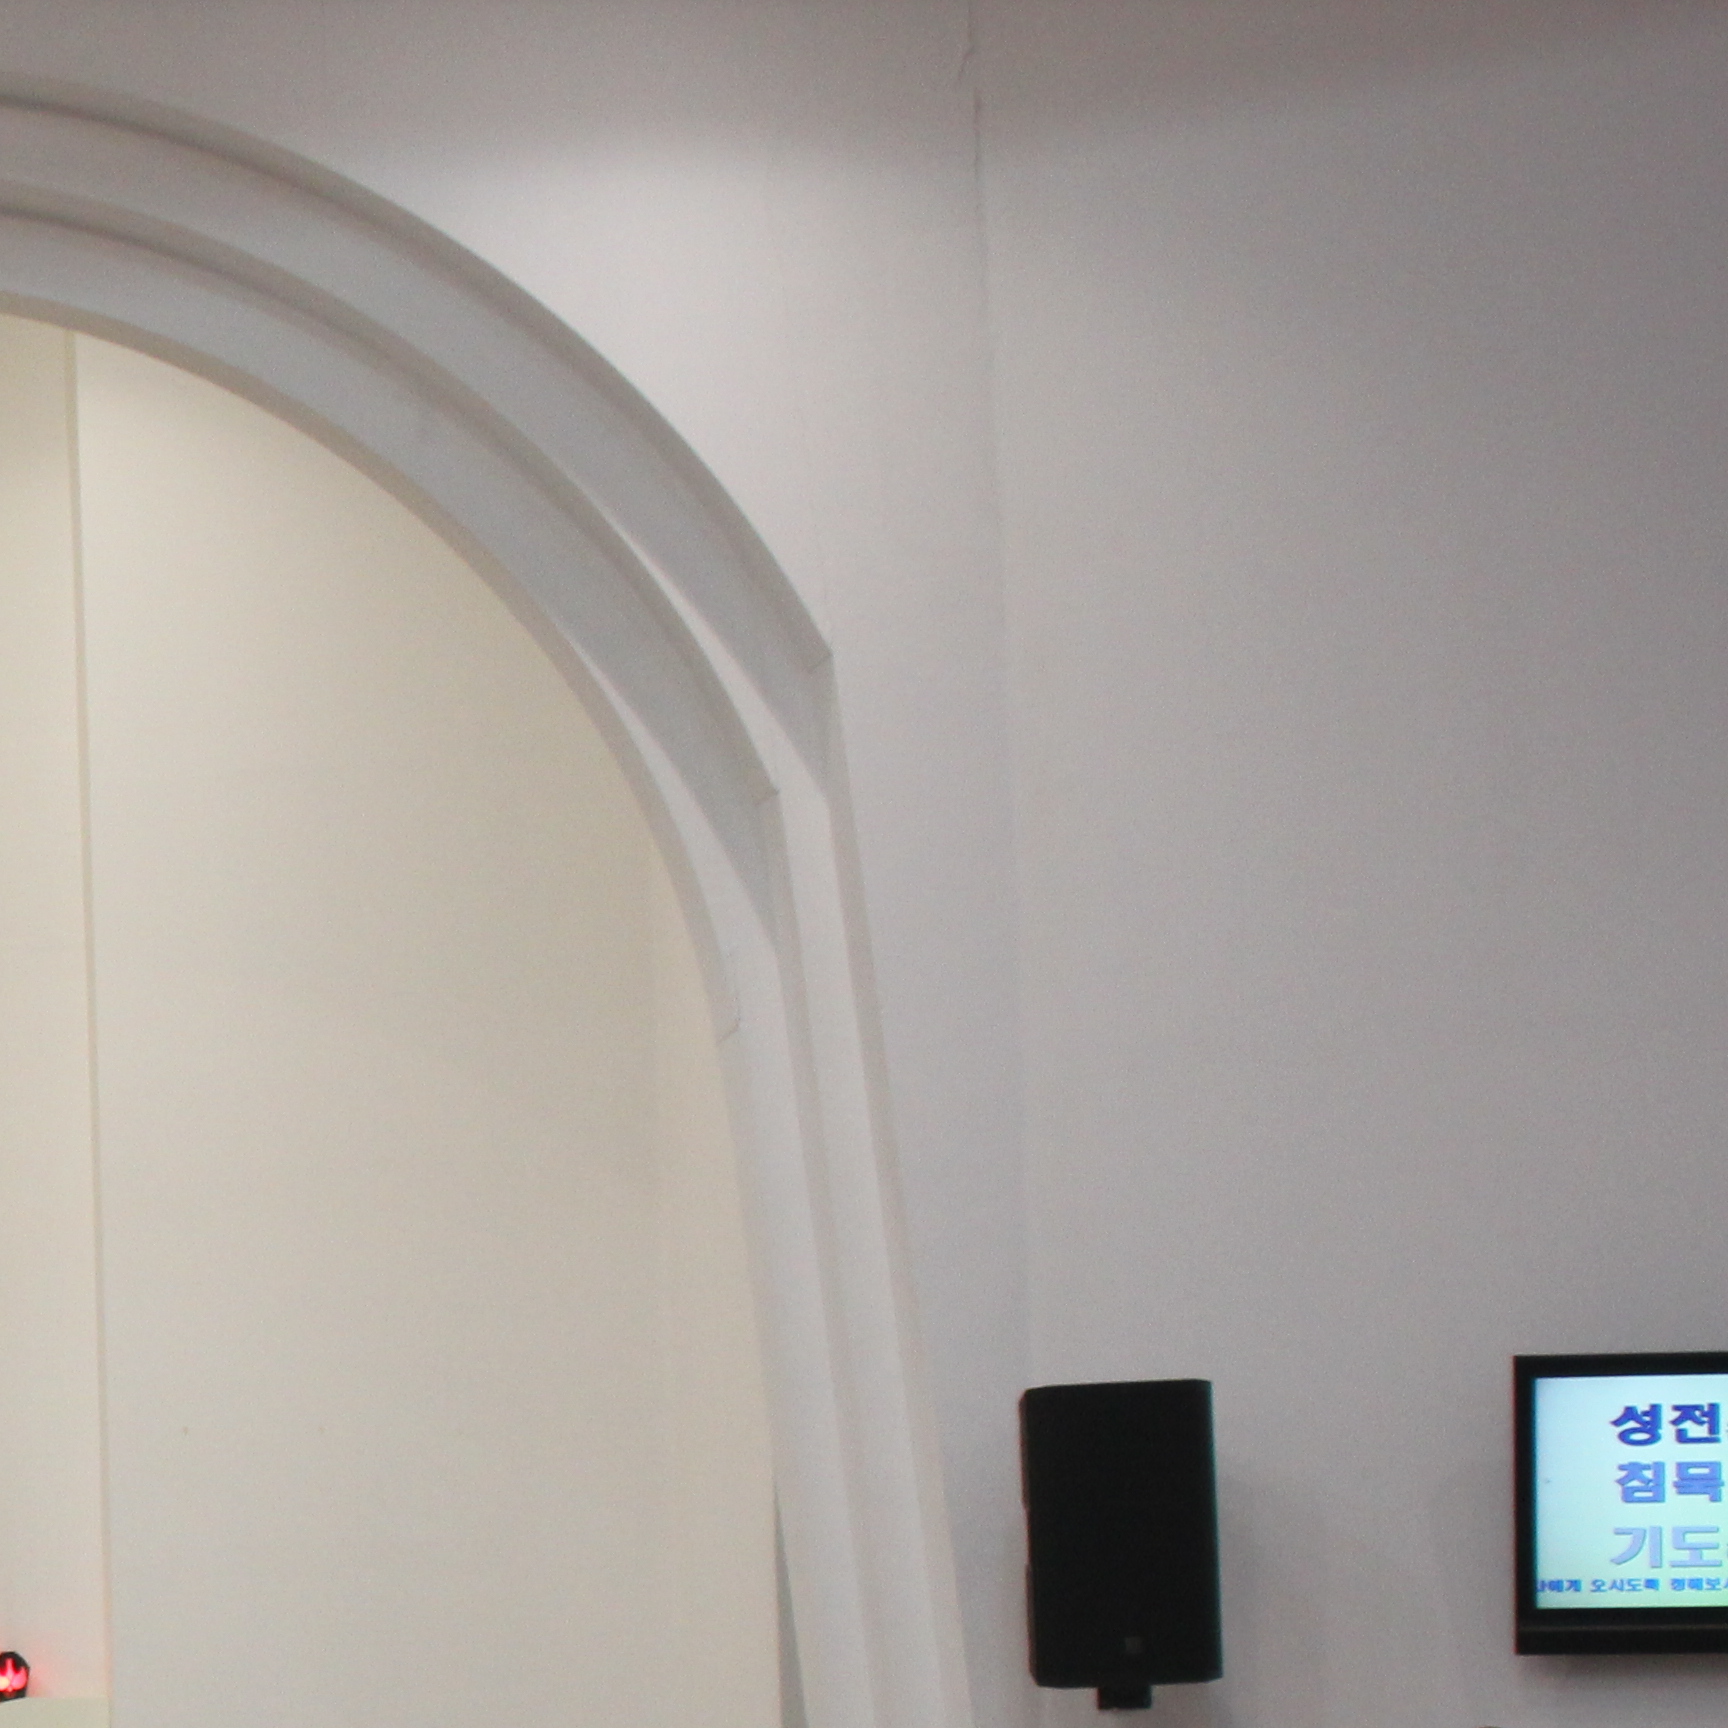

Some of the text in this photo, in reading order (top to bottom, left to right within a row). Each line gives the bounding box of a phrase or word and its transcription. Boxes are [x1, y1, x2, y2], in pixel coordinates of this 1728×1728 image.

[1609, 1403, 1728, 1446] 성전
[1610, 1525, 1728, 1568] 기도
[1670, 1577, 1728, 1592] 청해보
